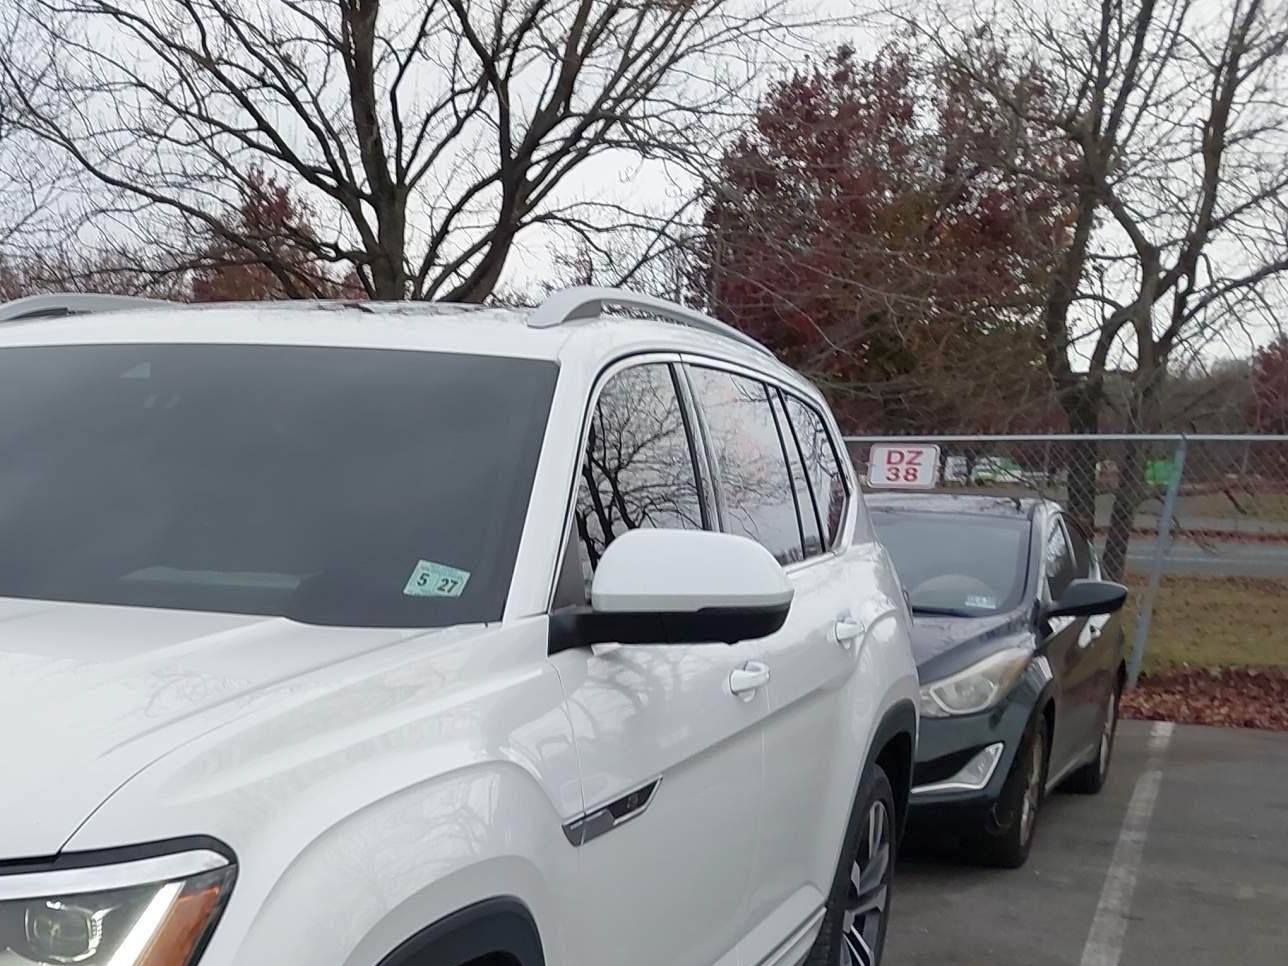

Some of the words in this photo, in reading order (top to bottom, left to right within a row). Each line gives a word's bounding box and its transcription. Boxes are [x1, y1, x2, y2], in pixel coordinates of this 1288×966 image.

[886, 449, 924, 466] DZ
[885, 466, 918, 482] 38
[416, 572, 430, 587] 5
[436, 577, 459, 594] 27
